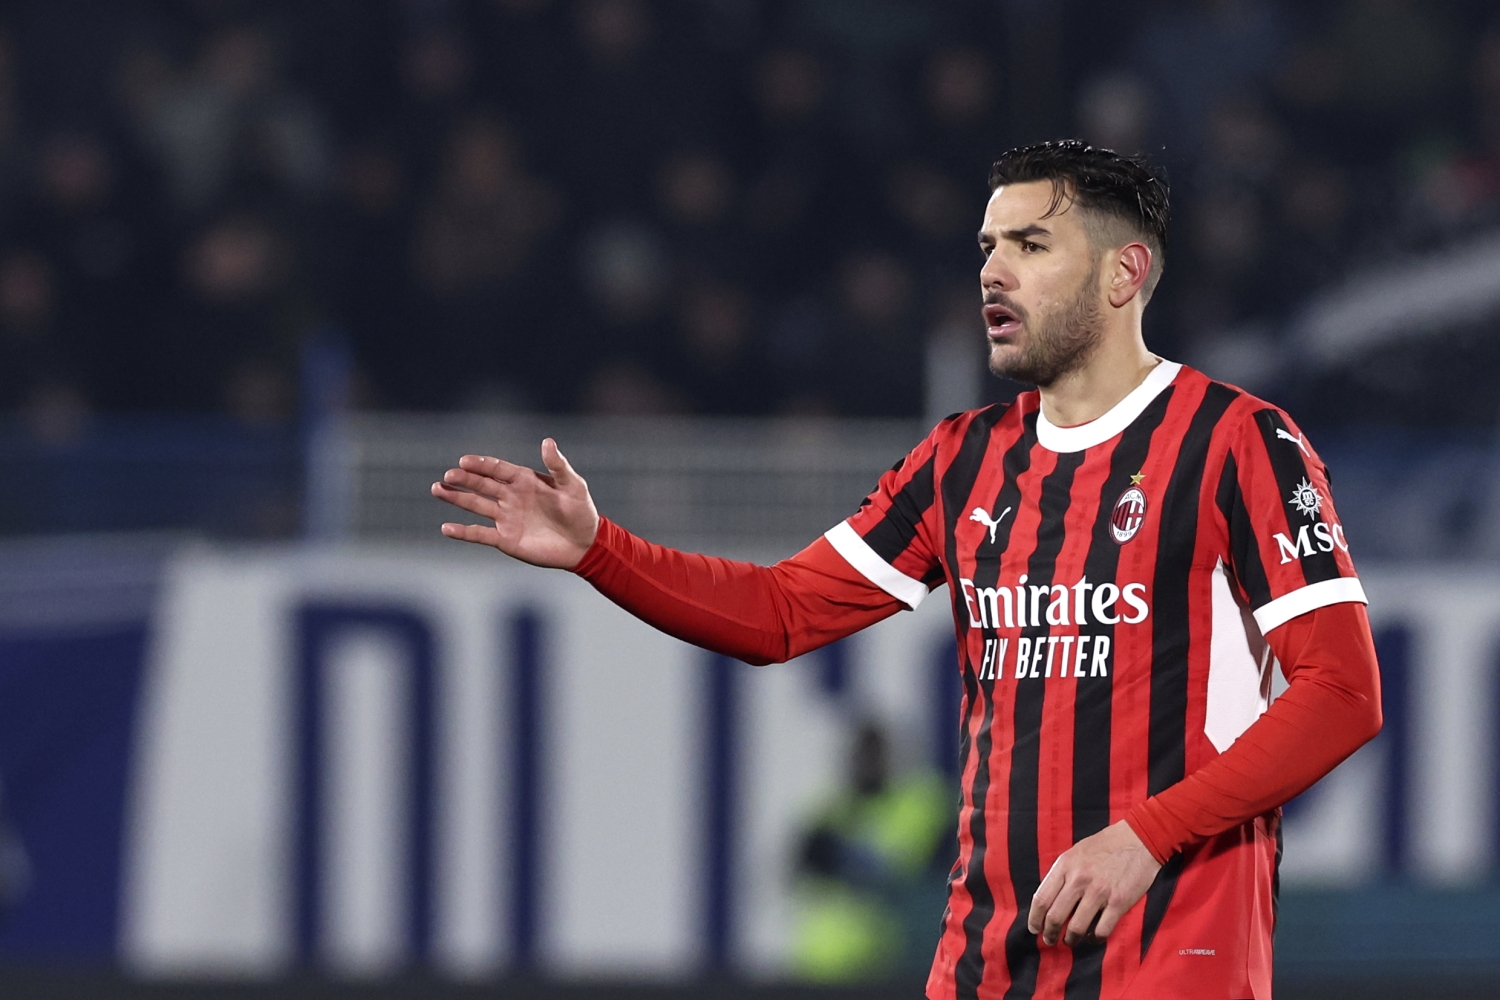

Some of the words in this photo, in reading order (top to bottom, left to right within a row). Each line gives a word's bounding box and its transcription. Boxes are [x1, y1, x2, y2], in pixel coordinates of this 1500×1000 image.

[1123, 491, 1142, 502] ACM
[1116, 530, 1133, 538] 1899
[1272, 521, 1349, 565] MSC
[959, 574, 1149, 629] Emirates
[979, 638, 1009, 680] FLY
[1015, 635, 1111, 679] BETTER
